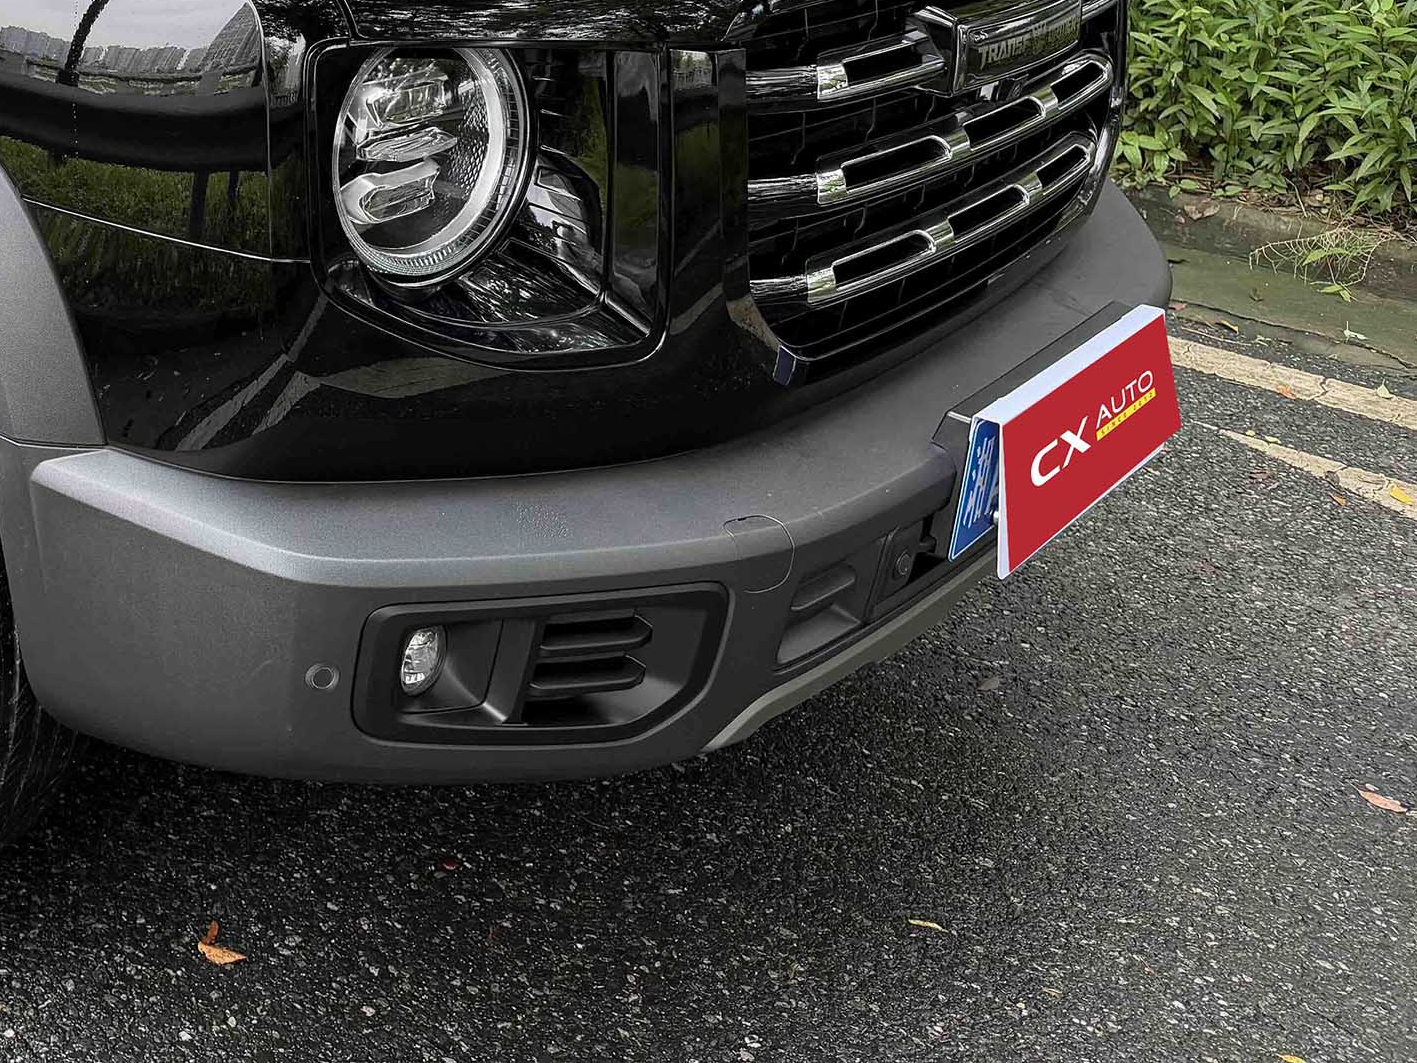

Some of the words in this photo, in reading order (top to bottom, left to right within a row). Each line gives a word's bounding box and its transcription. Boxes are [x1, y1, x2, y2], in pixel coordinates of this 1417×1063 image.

[1030, 415, 1092, 487] CX
[1096, 370, 1154, 430] AUTO
[1101, 412, 1127, 435] SINCE
